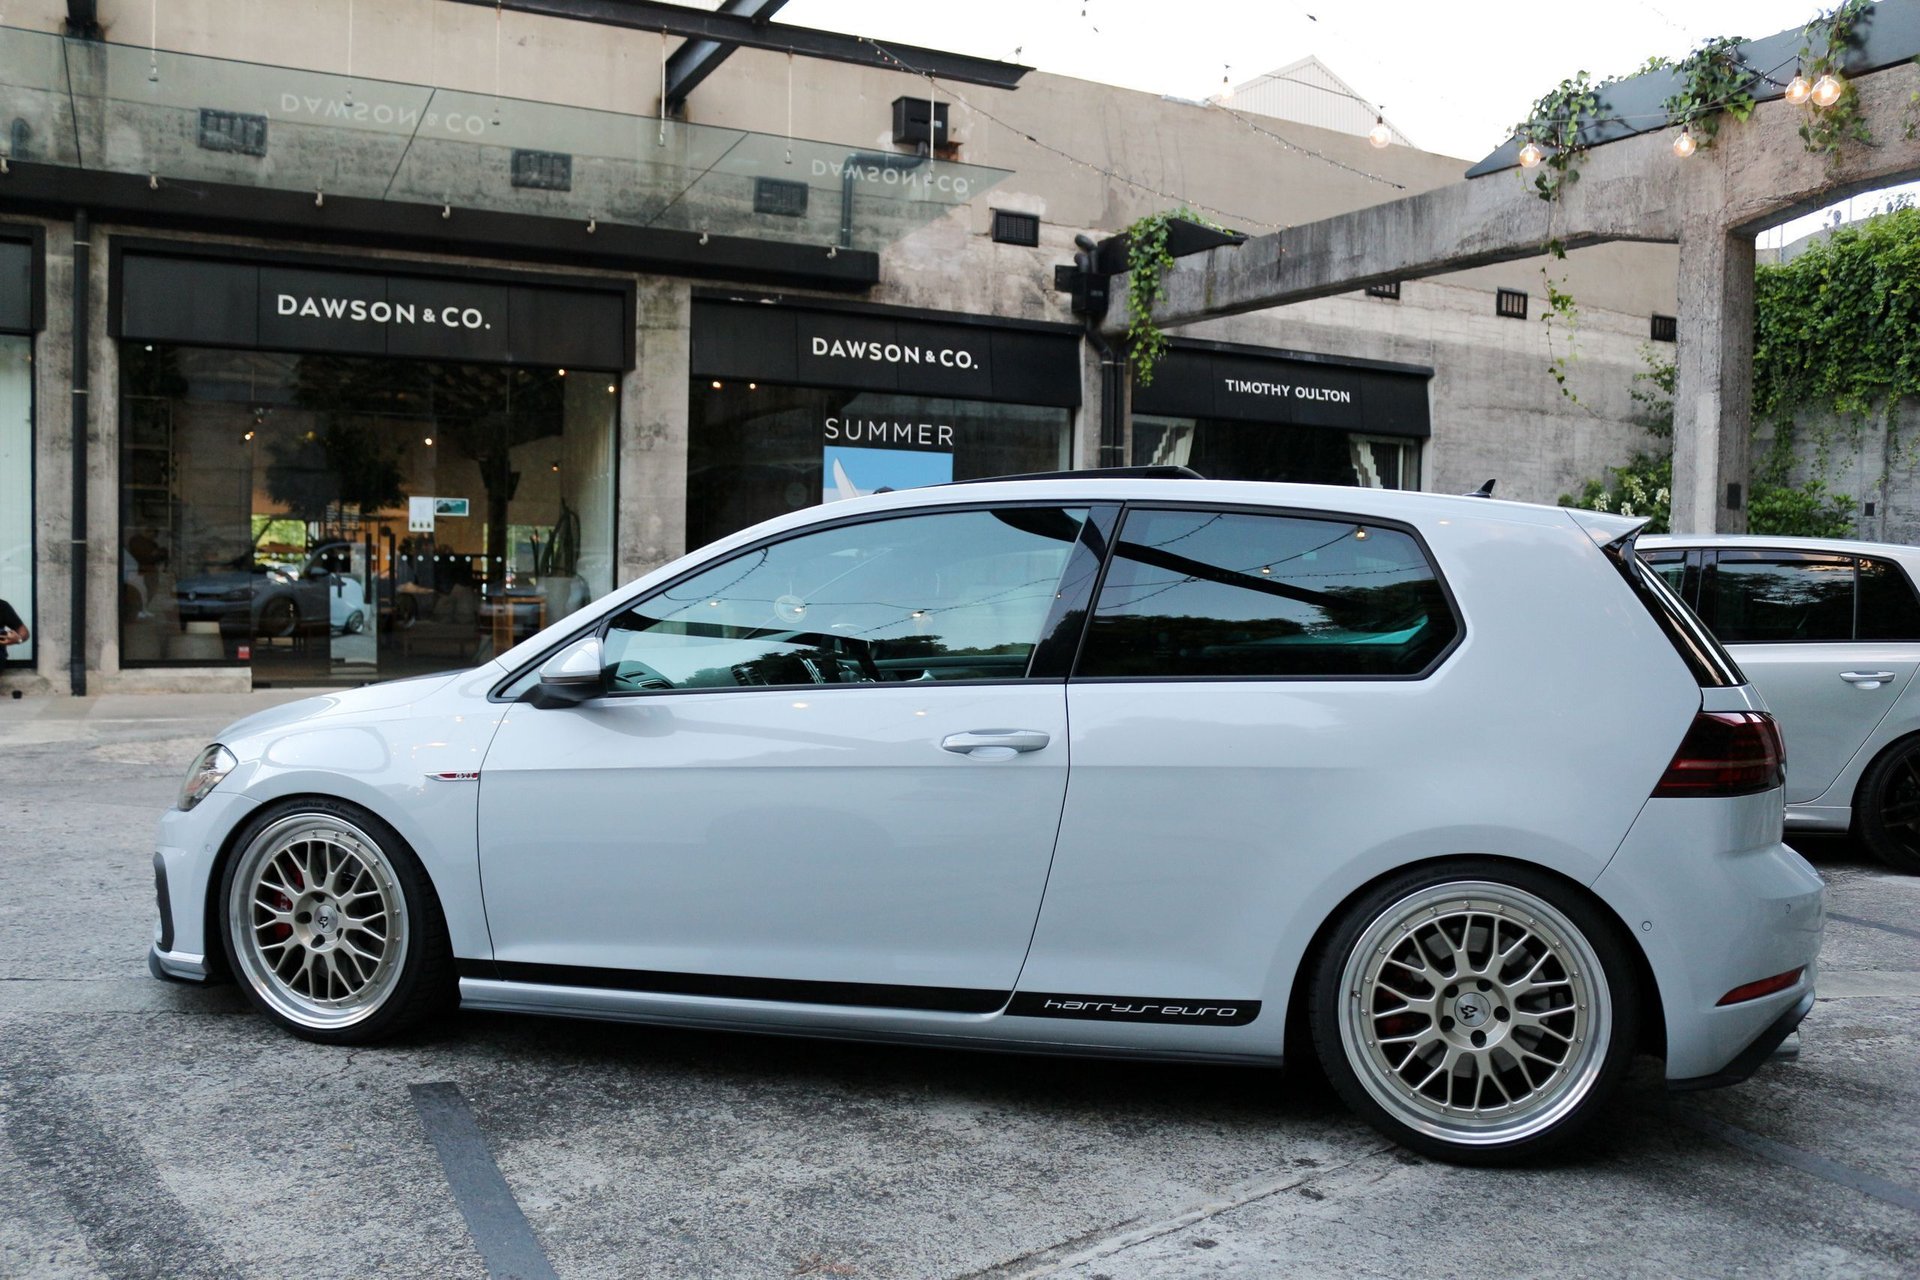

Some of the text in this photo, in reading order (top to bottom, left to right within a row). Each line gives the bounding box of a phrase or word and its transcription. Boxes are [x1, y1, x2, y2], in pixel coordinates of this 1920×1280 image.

[277, 294, 491, 330] DAWSON & CO.
[812, 337, 979, 370] DAWSON & CO.
[1225, 379, 1351, 403] TIMOTHY OULTON
[824, 418, 954, 446] SUMMER
